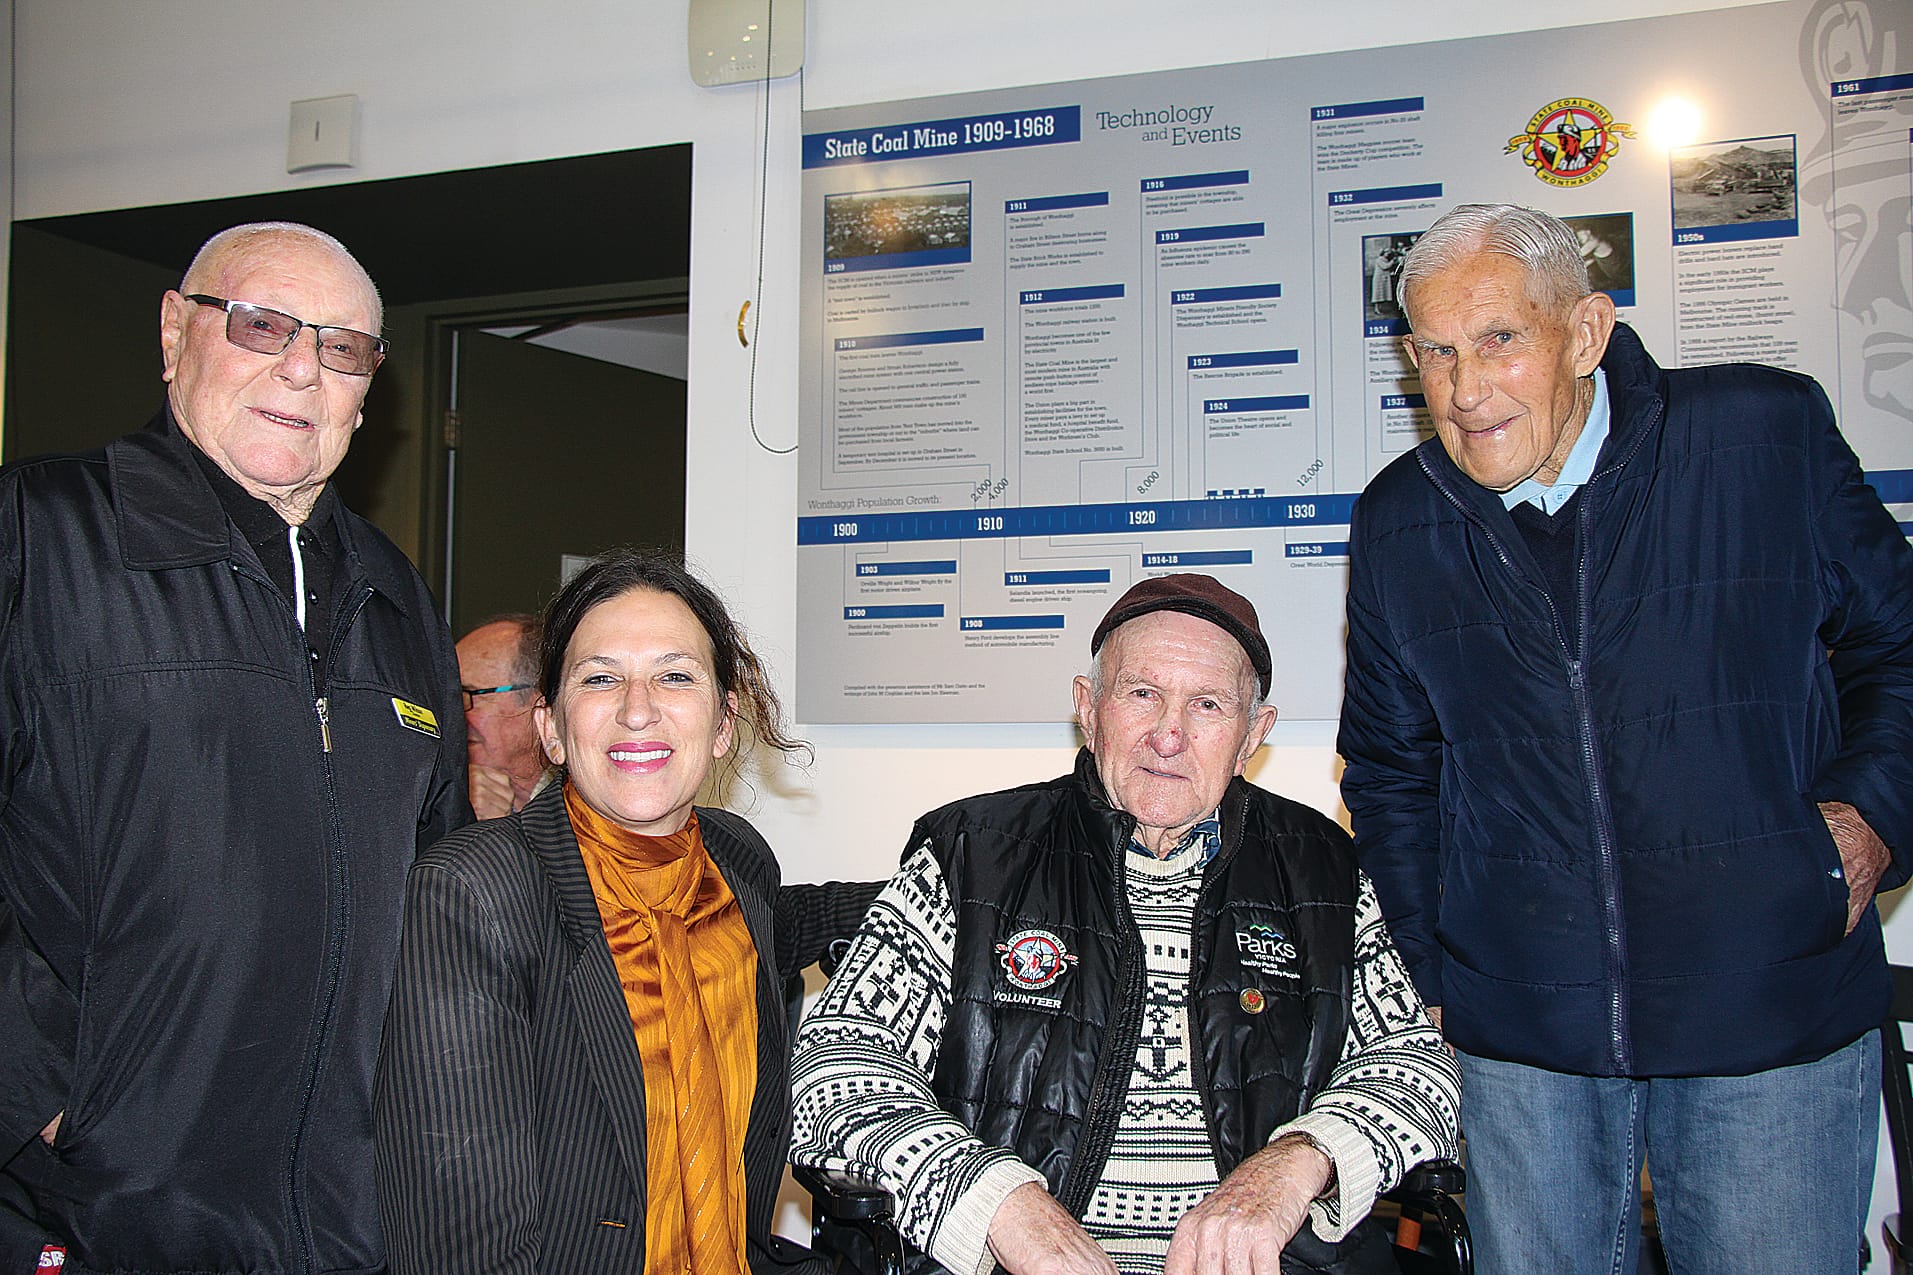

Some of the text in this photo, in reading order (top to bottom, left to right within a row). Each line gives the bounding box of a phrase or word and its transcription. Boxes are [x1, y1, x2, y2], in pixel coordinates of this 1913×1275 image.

[1838, 83, 1859, 93] 1961
[1096, 105, 1214, 130] Technology
[1530, 106, 1552, 126] STATE
[1588, 103, 1608, 120] MINE
[825, 116, 1054, 158] State Coal Mine 1909-1968
[1142, 125, 1241, 146] and Events
[1542, 169, 1601, 186] WONTHAGGI
[1193, 358, 1211, 366] 1923
[1296, 459, 1324, 488] 12,000
[971, 479, 992, 502] 2,000
[988, 478, 1009, 501] 4,000
[1136, 471, 1160, 495] 8,000
[808, 496, 942, 510] Wonthaggi Population Growth:
[1288, 504, 1315, 518] 1930
[977, 517, 1003, 531] 1910
[1129, 510, 1155, 524] 1920
[834, 523, 857, 537] 1900
[1290, 546, 1322, 554] 1929-39
[1236, 932, 1296, 958] Parks
[1255, 954, 1286, 963] VICTORIA
[993, 990, 1061, 1008] VOLUNTEER
